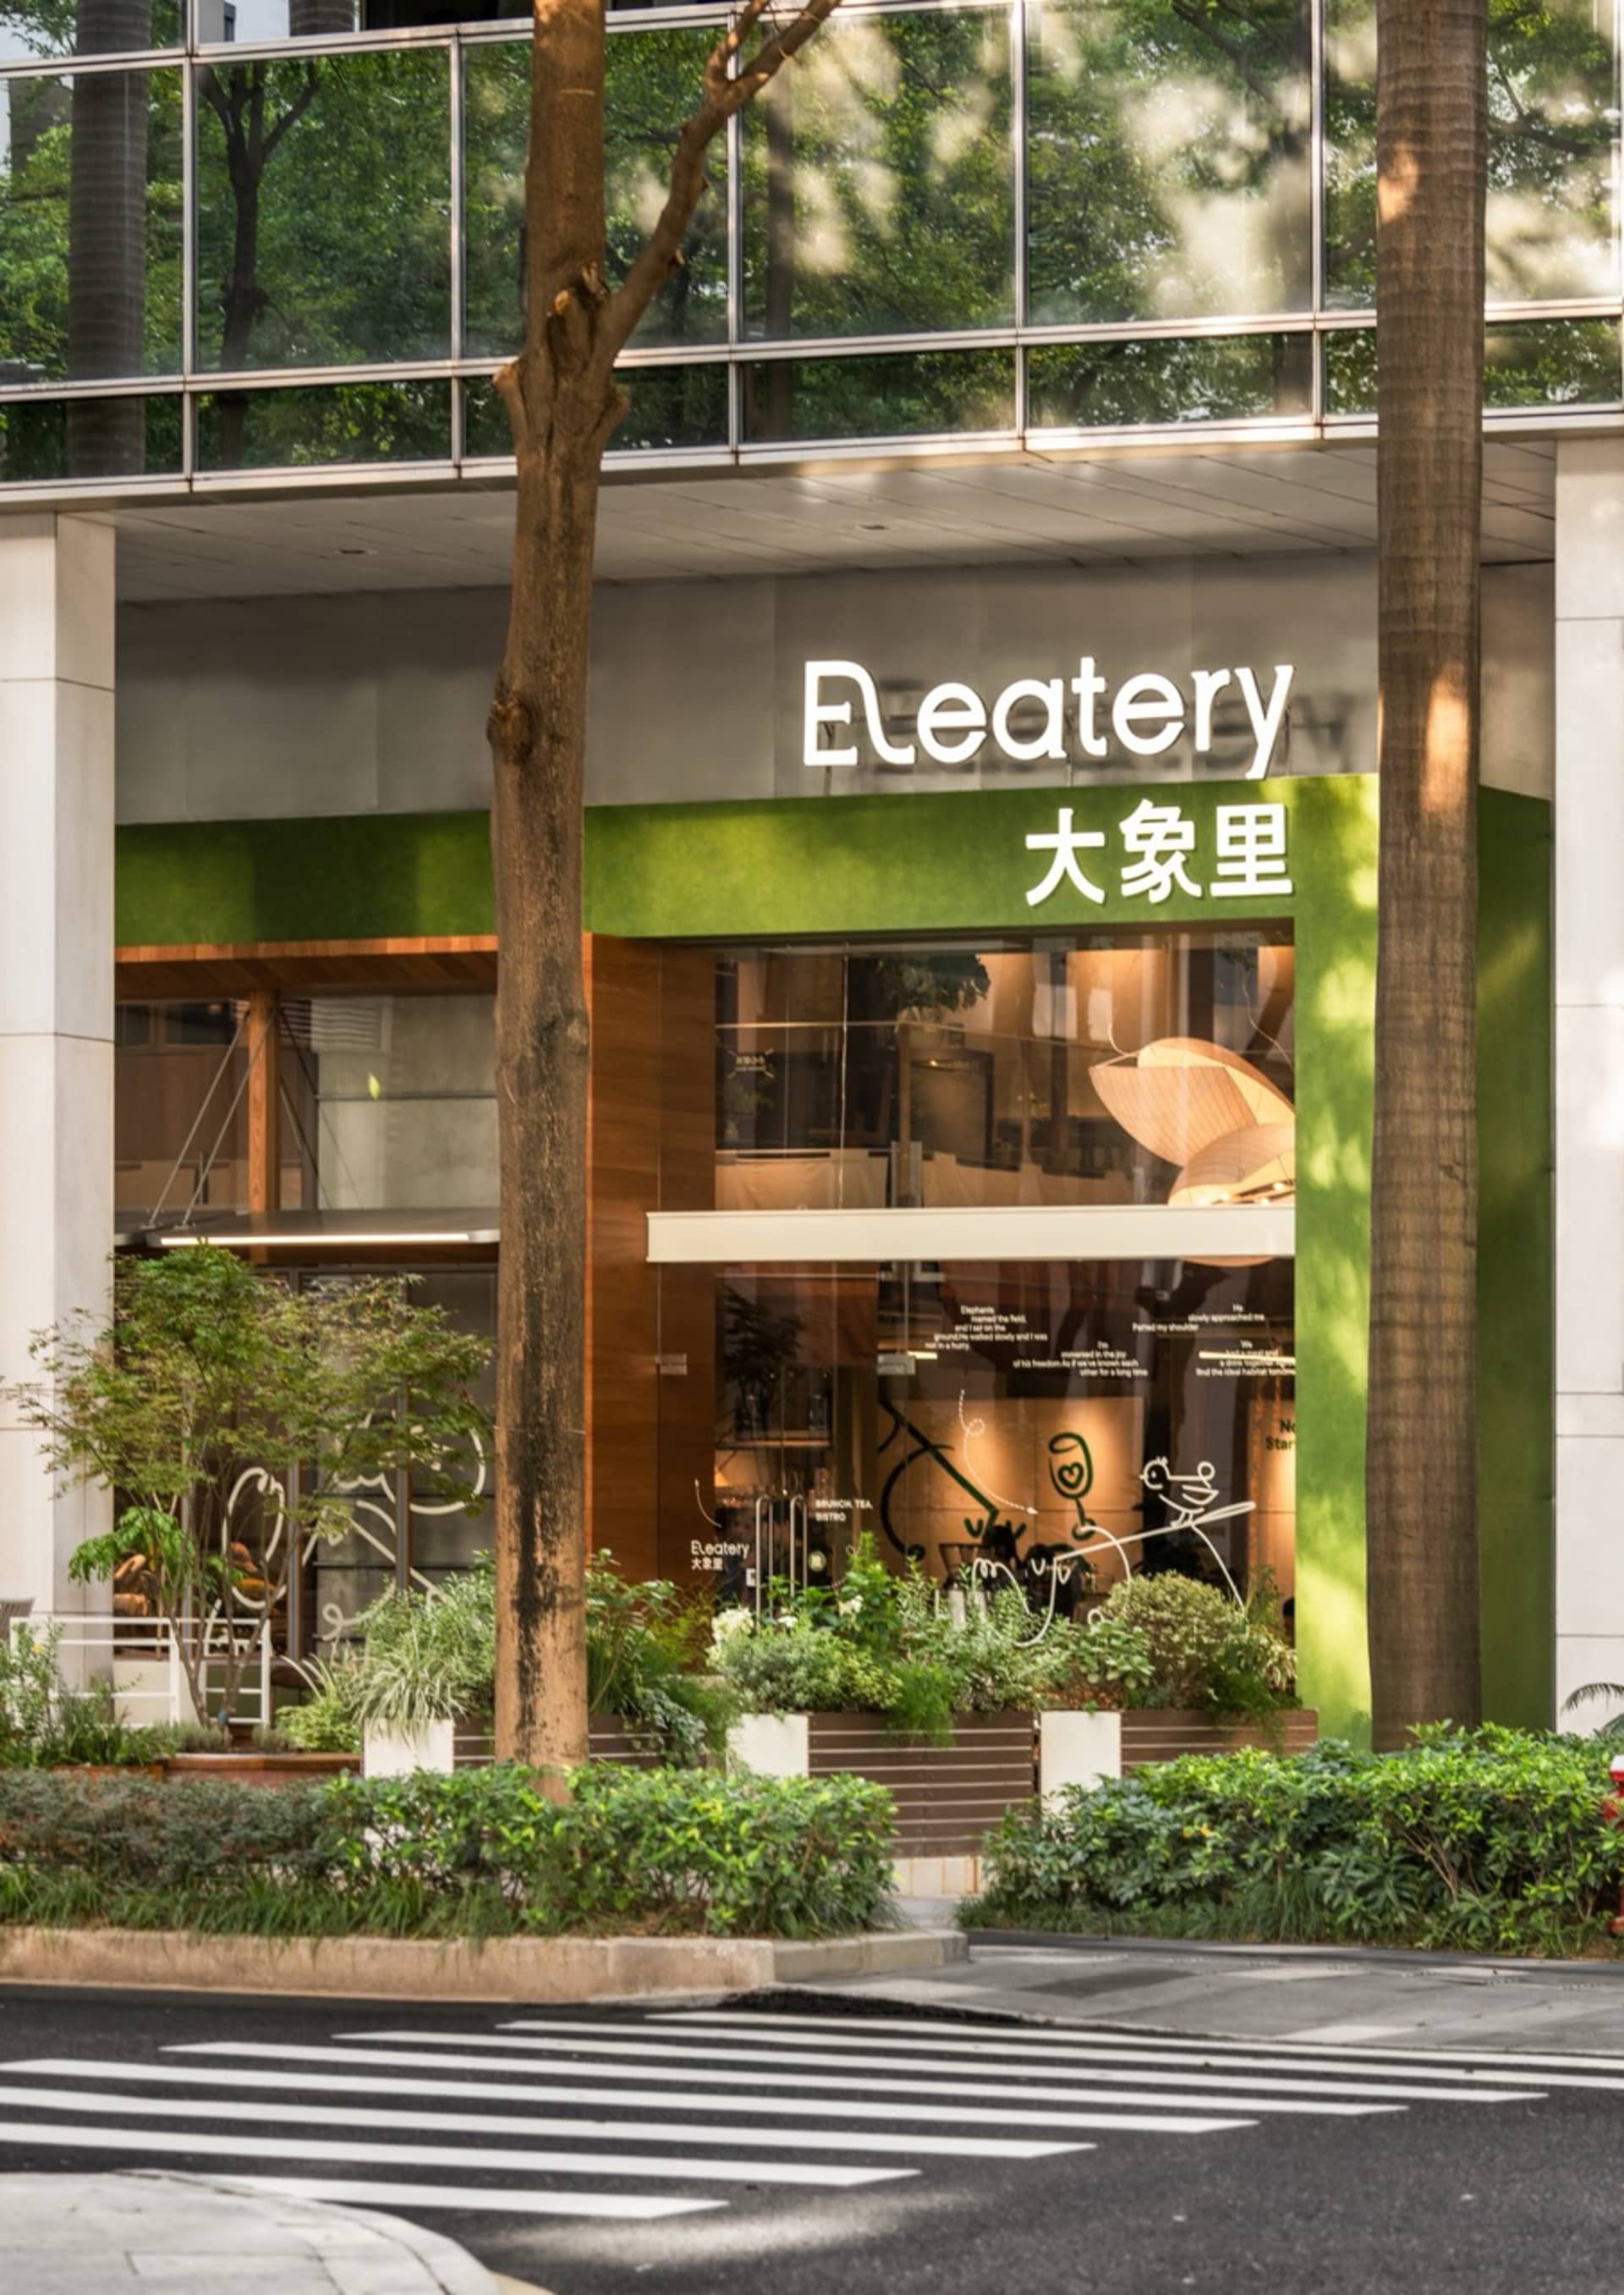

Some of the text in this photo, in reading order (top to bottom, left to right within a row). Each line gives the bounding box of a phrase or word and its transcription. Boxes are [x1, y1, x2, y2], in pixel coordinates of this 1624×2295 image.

[1024, 798, 1293, 907] 大象里
[998, 1315, 1009, 1323] the
[995, 1324, 1006, 1332] the
[1156, 1324, 1167, 1333] my
[1168, 1322, 1199, 1331] shoulder
[969, 1332, 993, 1341] walked
[995, 1332, 1014, 1342] slowly
[1016, 1332, 1029, 1341] and
[1034, 1333, 1047, 1342] was
[1102, 1350, 1115, 1359] the
[1122, 1359, 1139, 1368] each
[1100, 1368, 1109, 1376] for
[1116, 1368, 1132, 1378] long
[1211, 1367, 1223, 1376] the
[691, 1557, 724, 1571] 大象里
